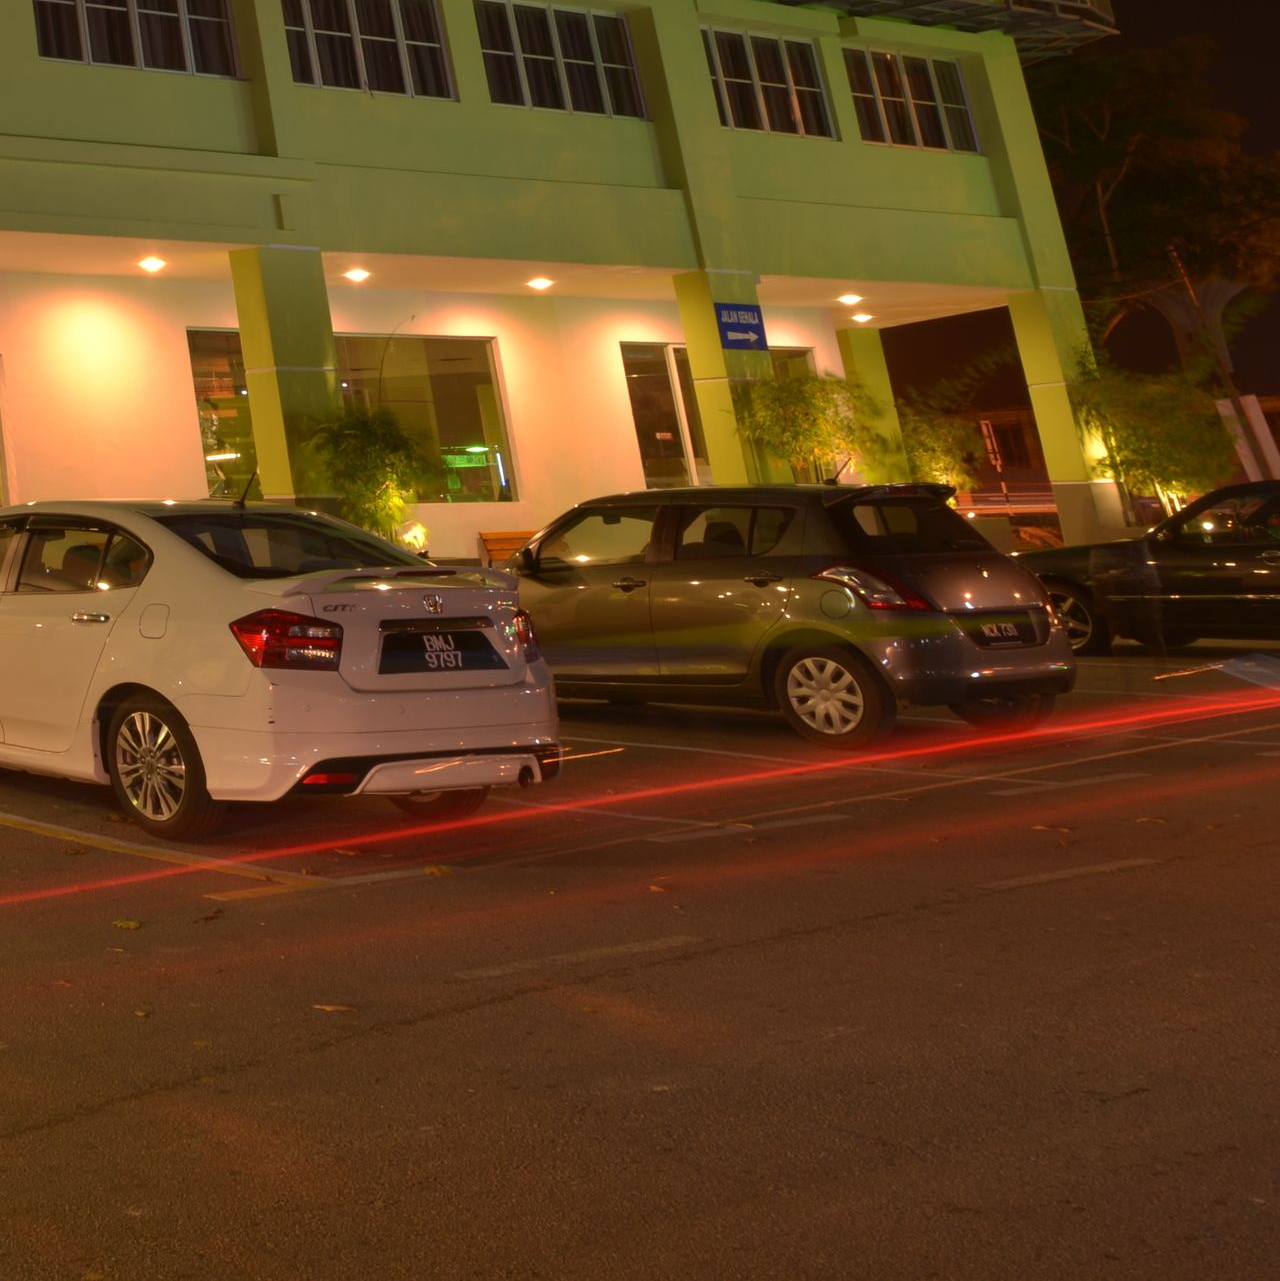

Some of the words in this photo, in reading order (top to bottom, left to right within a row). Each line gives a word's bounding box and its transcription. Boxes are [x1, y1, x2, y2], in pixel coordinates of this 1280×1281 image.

[721, 310, 738, 323] JALAN
[322, 603, 357, 613] CITY
[422, 634, 455, 652] BMJ
[424, 650, 463, 668] 9797
